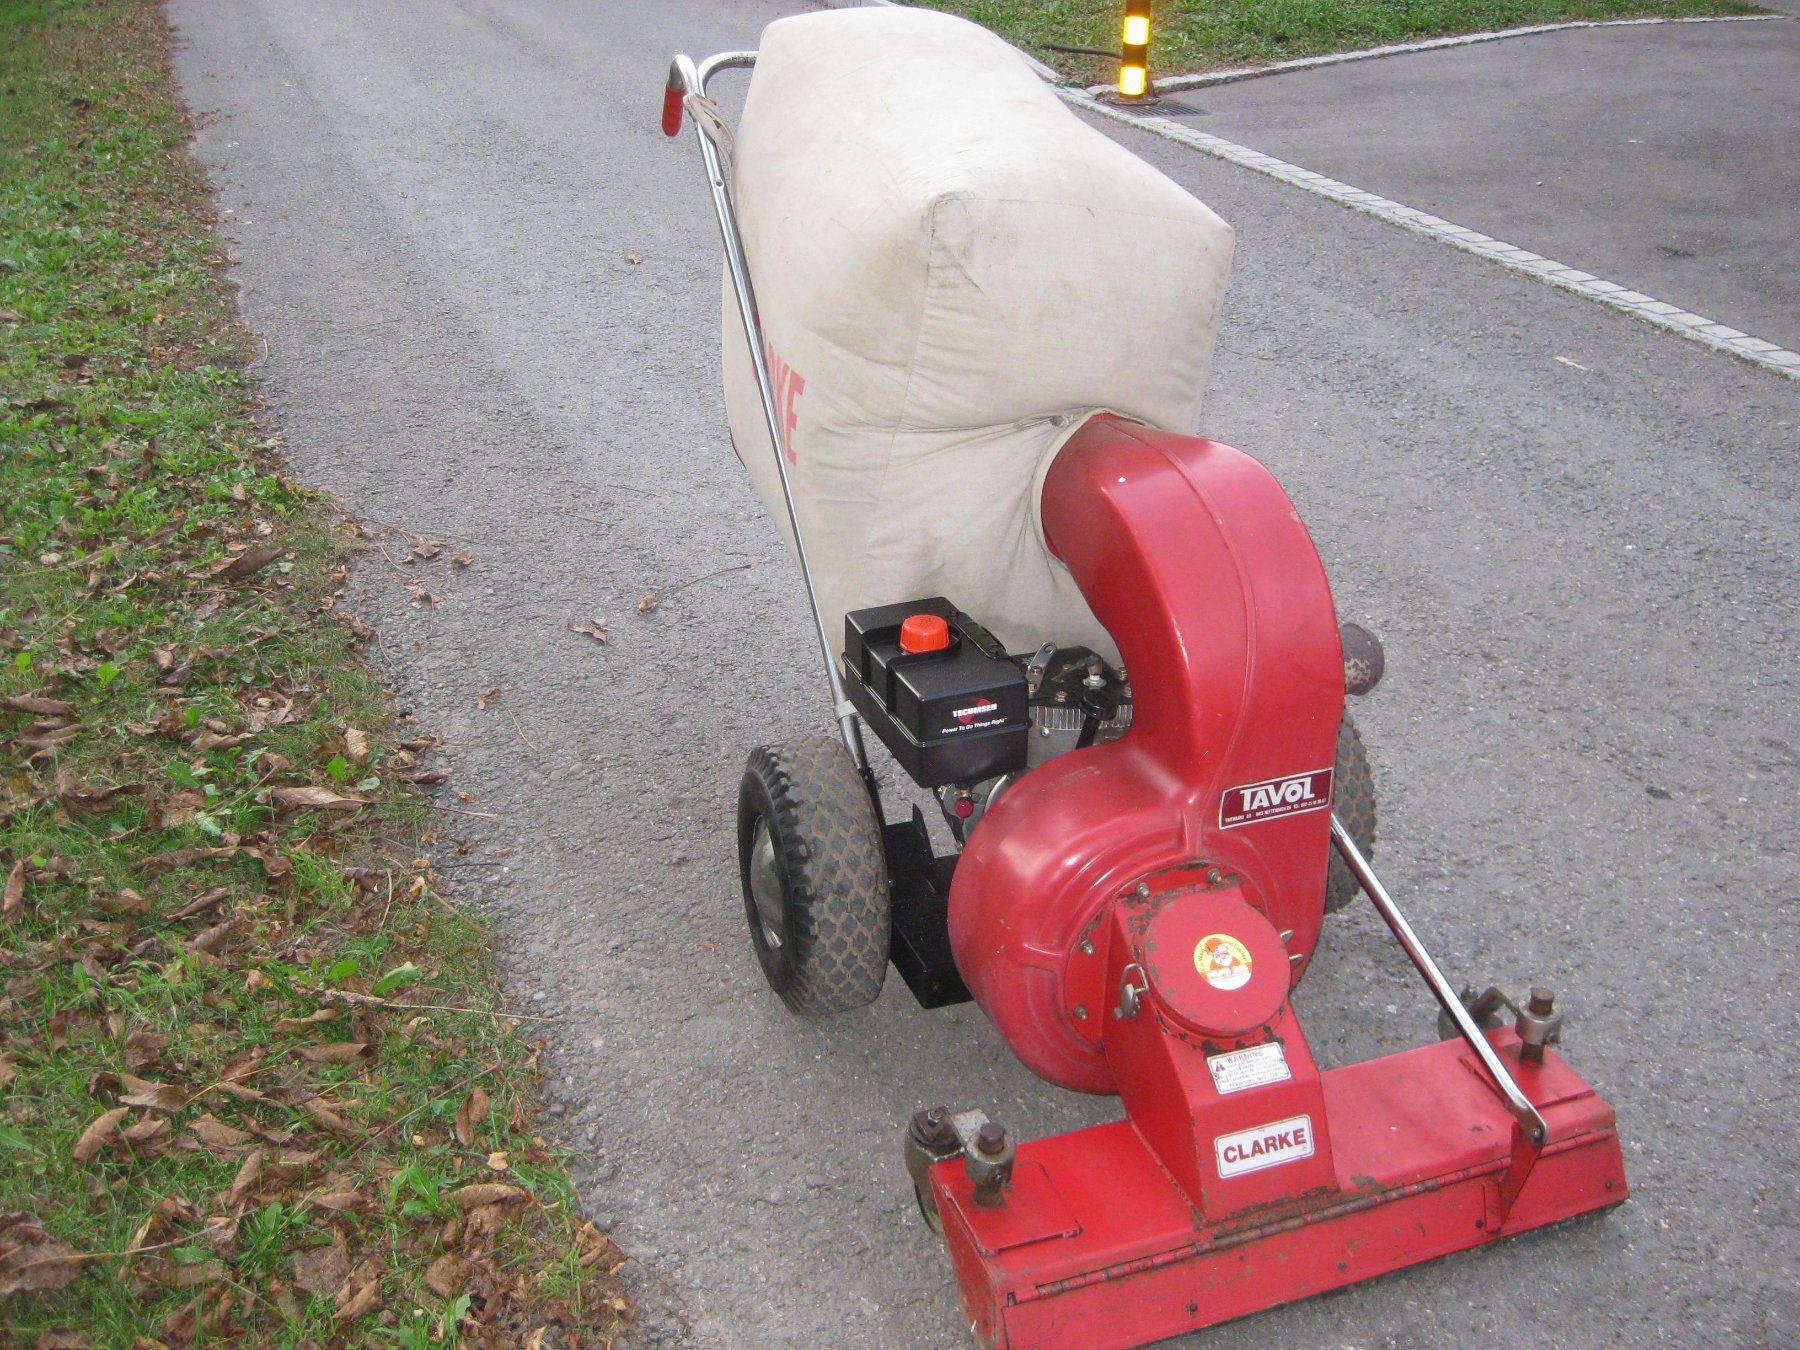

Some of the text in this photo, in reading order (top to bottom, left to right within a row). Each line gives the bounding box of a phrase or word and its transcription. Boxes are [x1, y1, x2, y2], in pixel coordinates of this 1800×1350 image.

[941, 726, 958, 734] Power
[1239, 777, 1315, 812] TAVOL
[1226, 1050, 1264, 1063] WARNING
[1223, 1127, 1307, 1163] CLARKE
